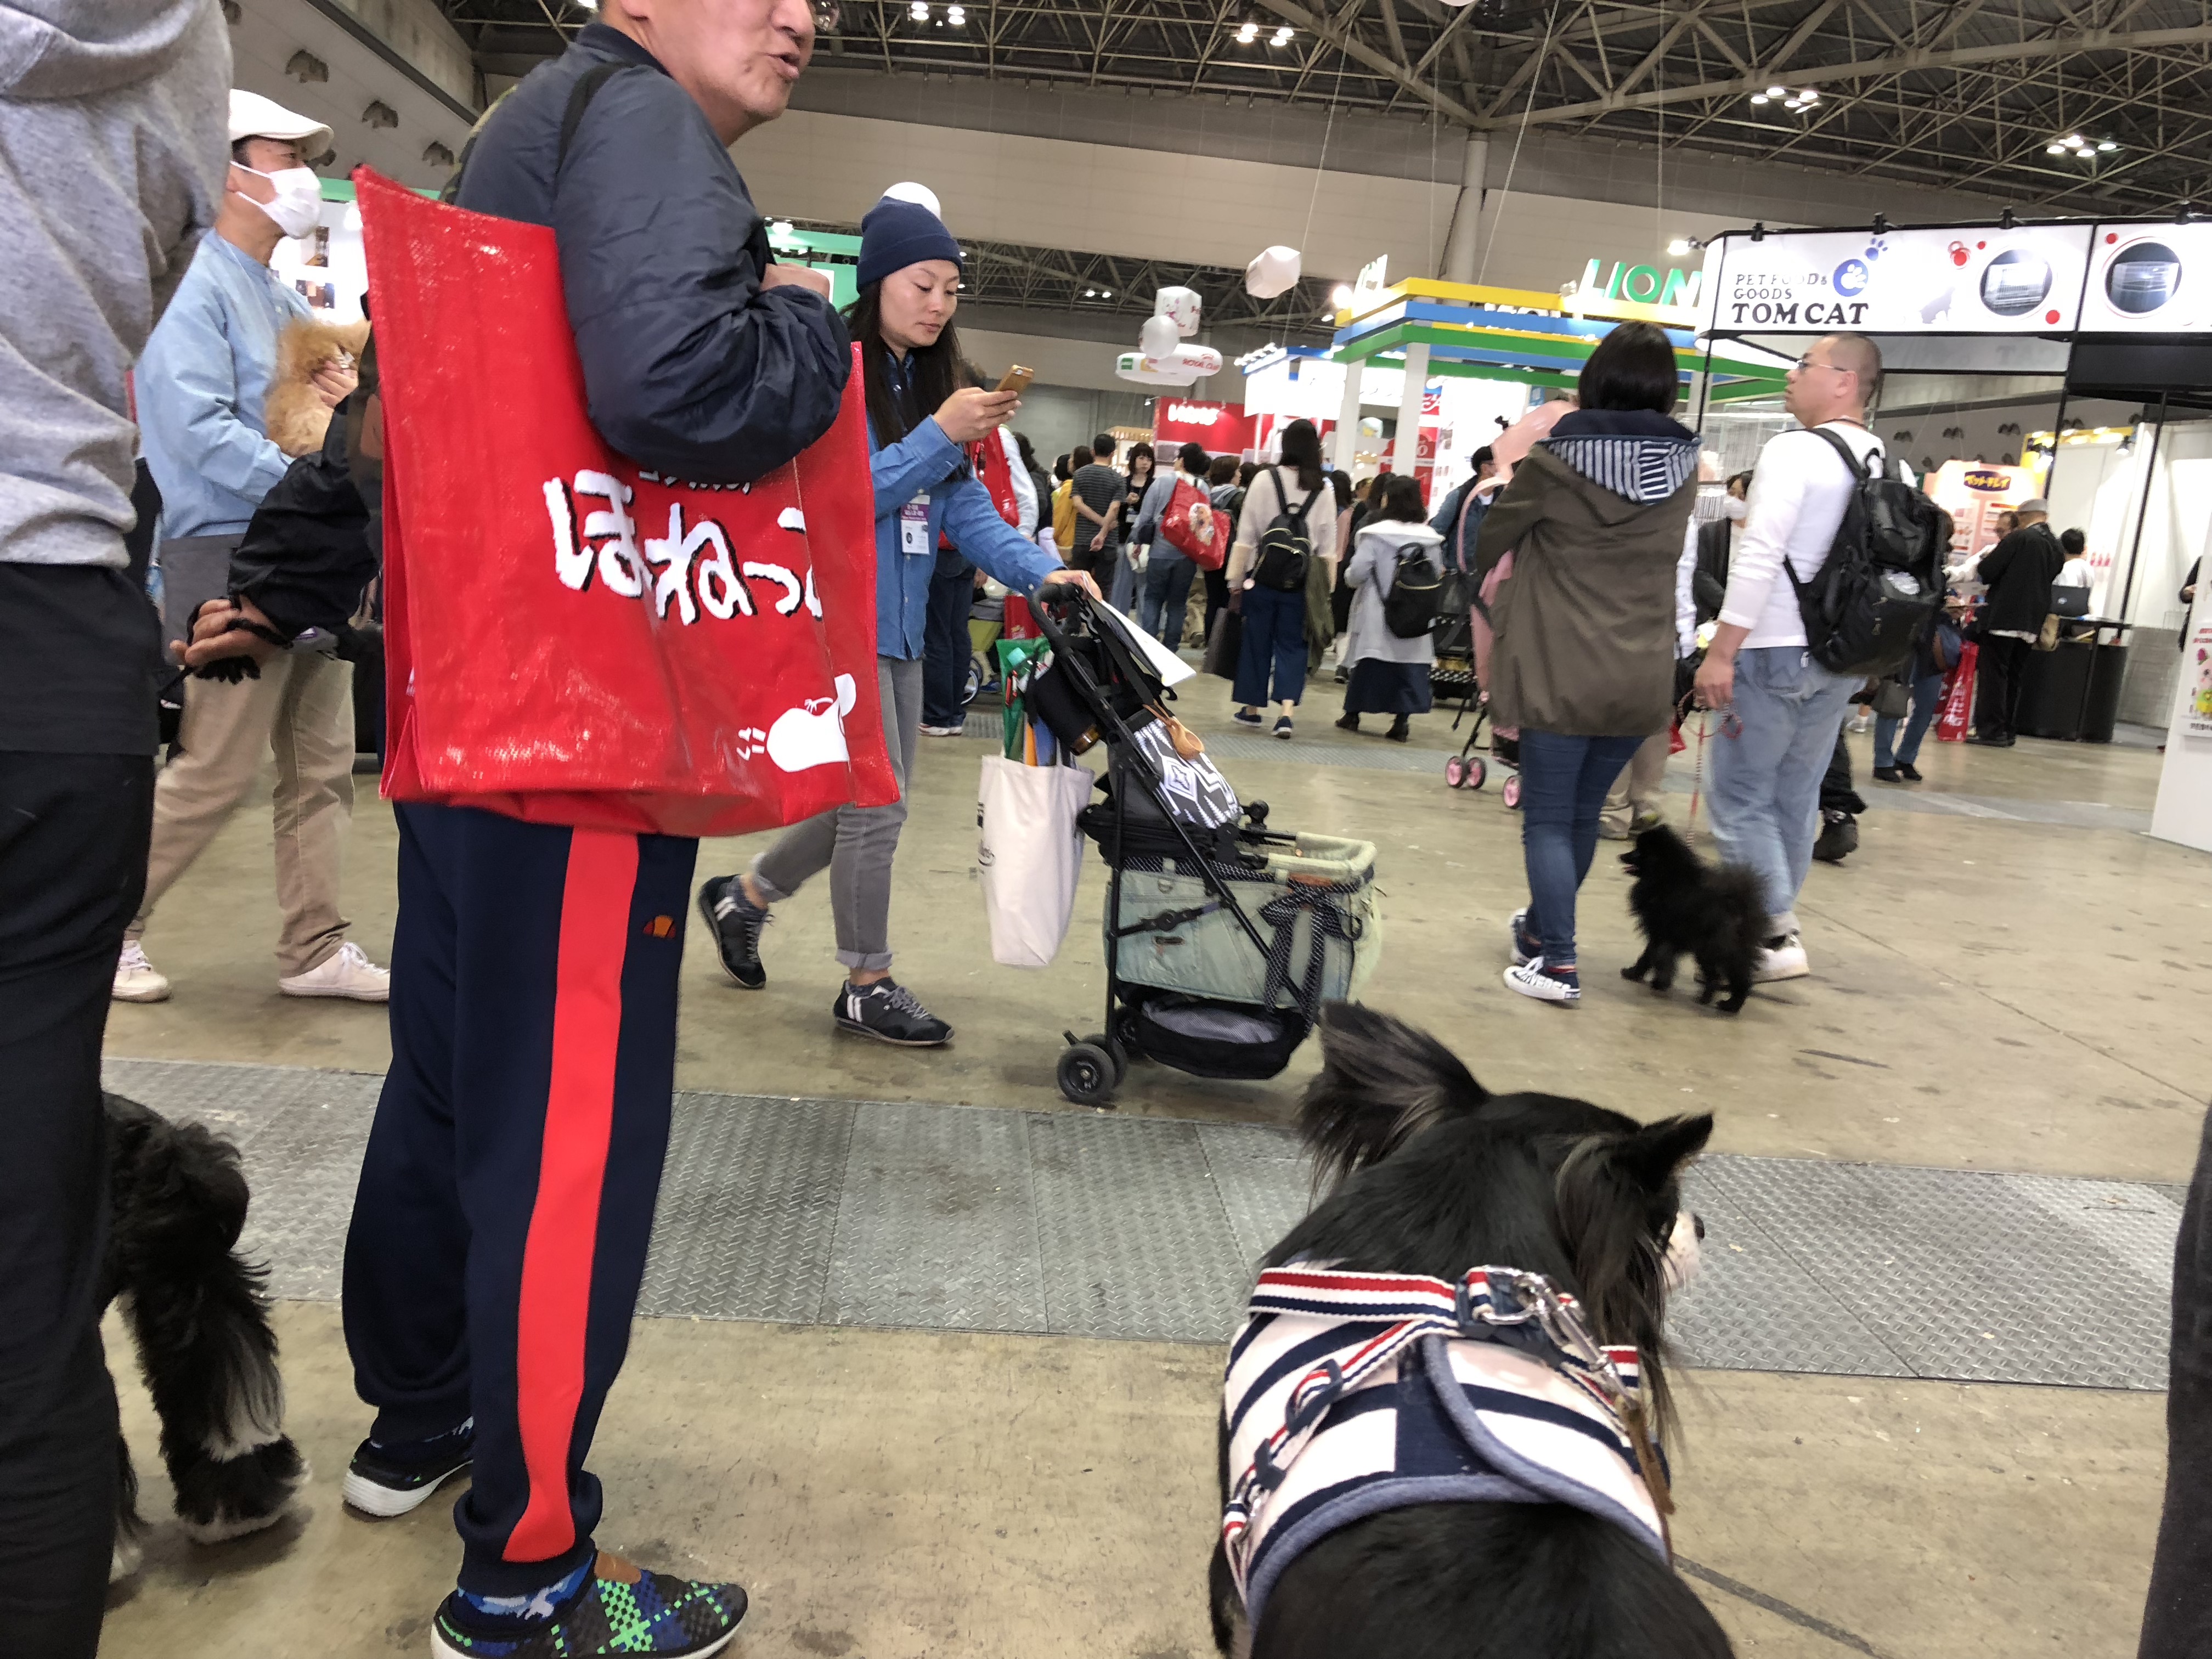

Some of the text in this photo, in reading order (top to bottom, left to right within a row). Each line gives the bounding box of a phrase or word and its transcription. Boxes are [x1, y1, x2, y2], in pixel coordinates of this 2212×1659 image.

[1577, 258, 1703, 307] LION
[1735, 274, 1766, 285] PET
[1734, 288, 1792, 300] GOODS
[1731, 302, 1869, 325] TOM CAT
